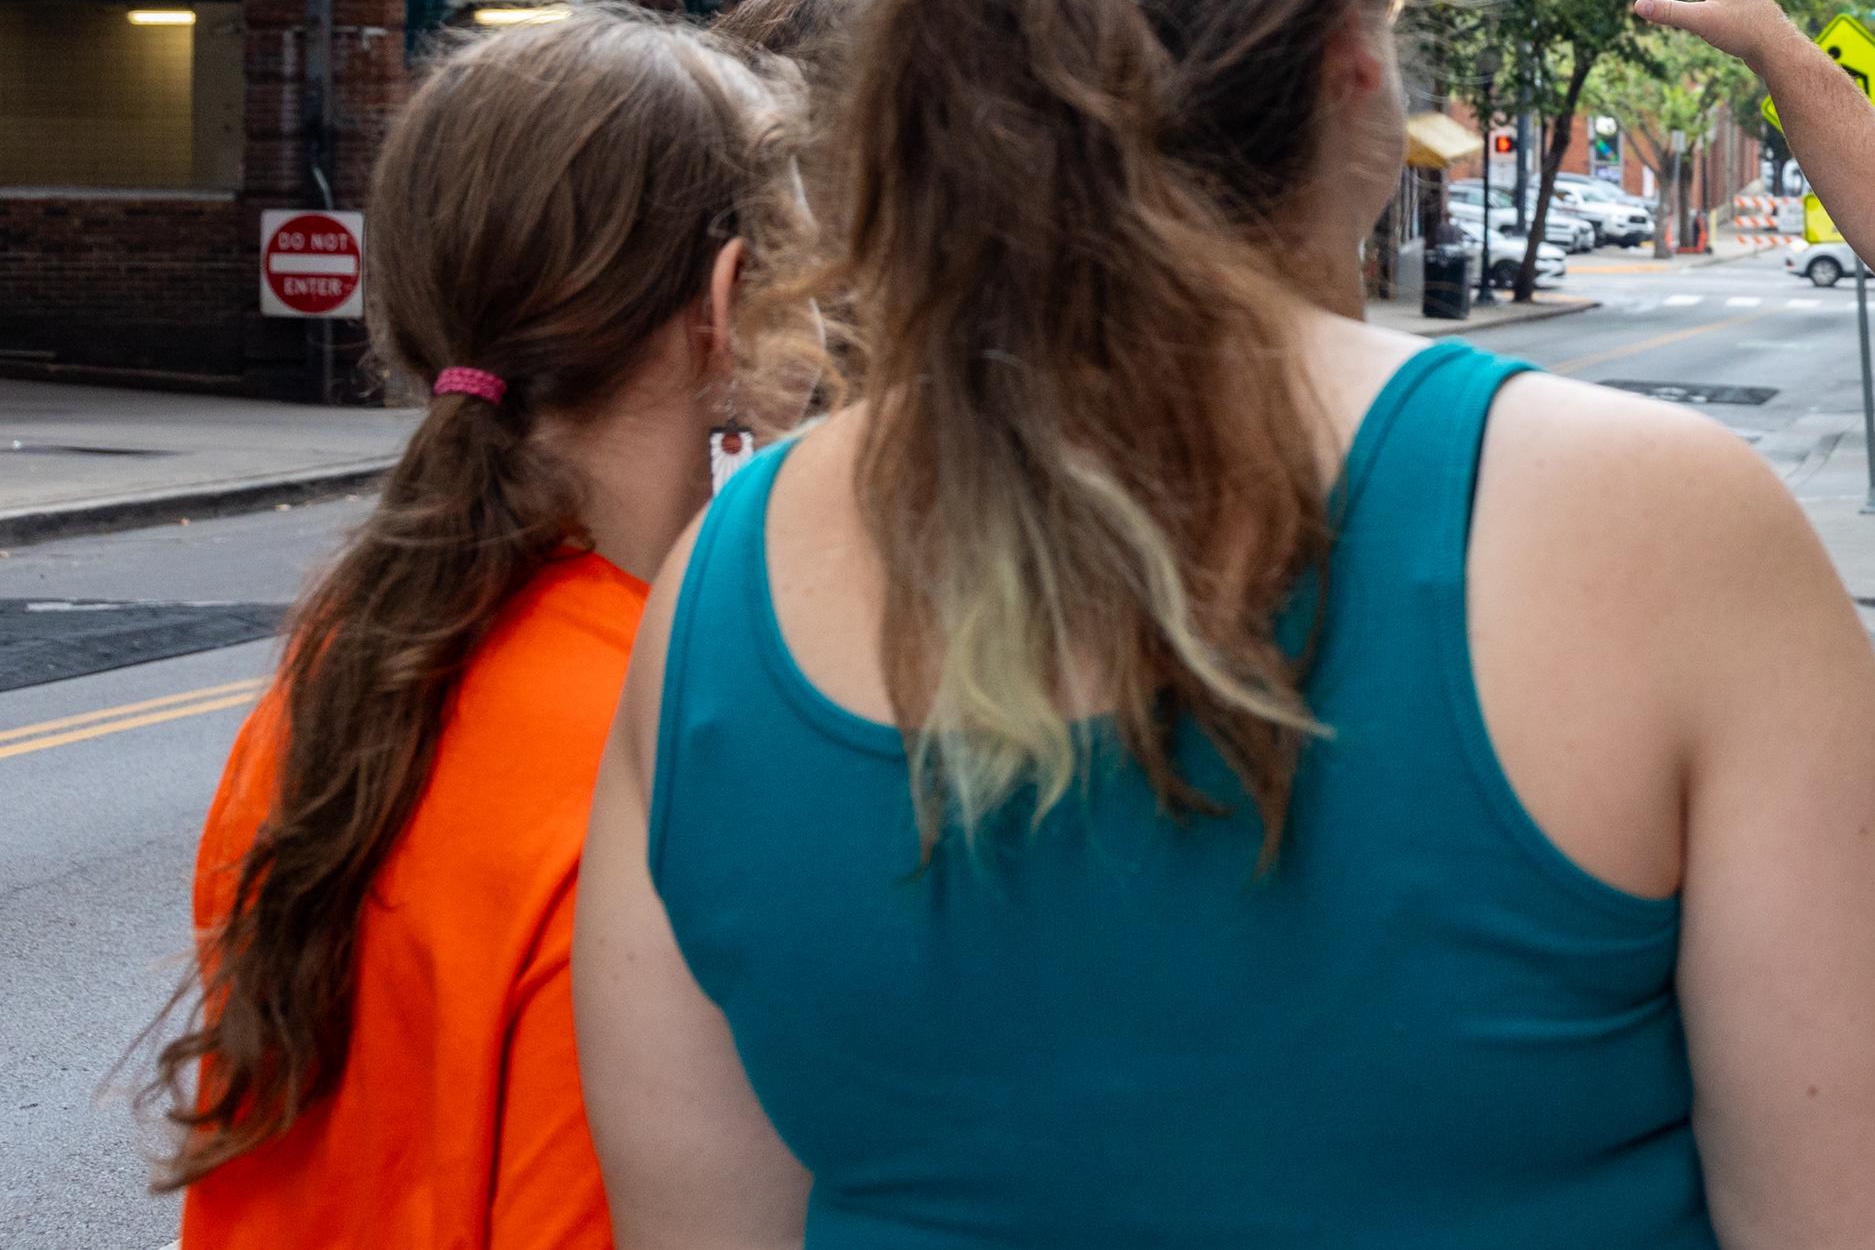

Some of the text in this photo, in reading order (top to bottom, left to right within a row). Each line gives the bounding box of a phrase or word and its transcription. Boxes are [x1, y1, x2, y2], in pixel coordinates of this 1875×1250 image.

[277, 231, 348, 252] DO NOT
[283, 276, 342, 297] ENTER
